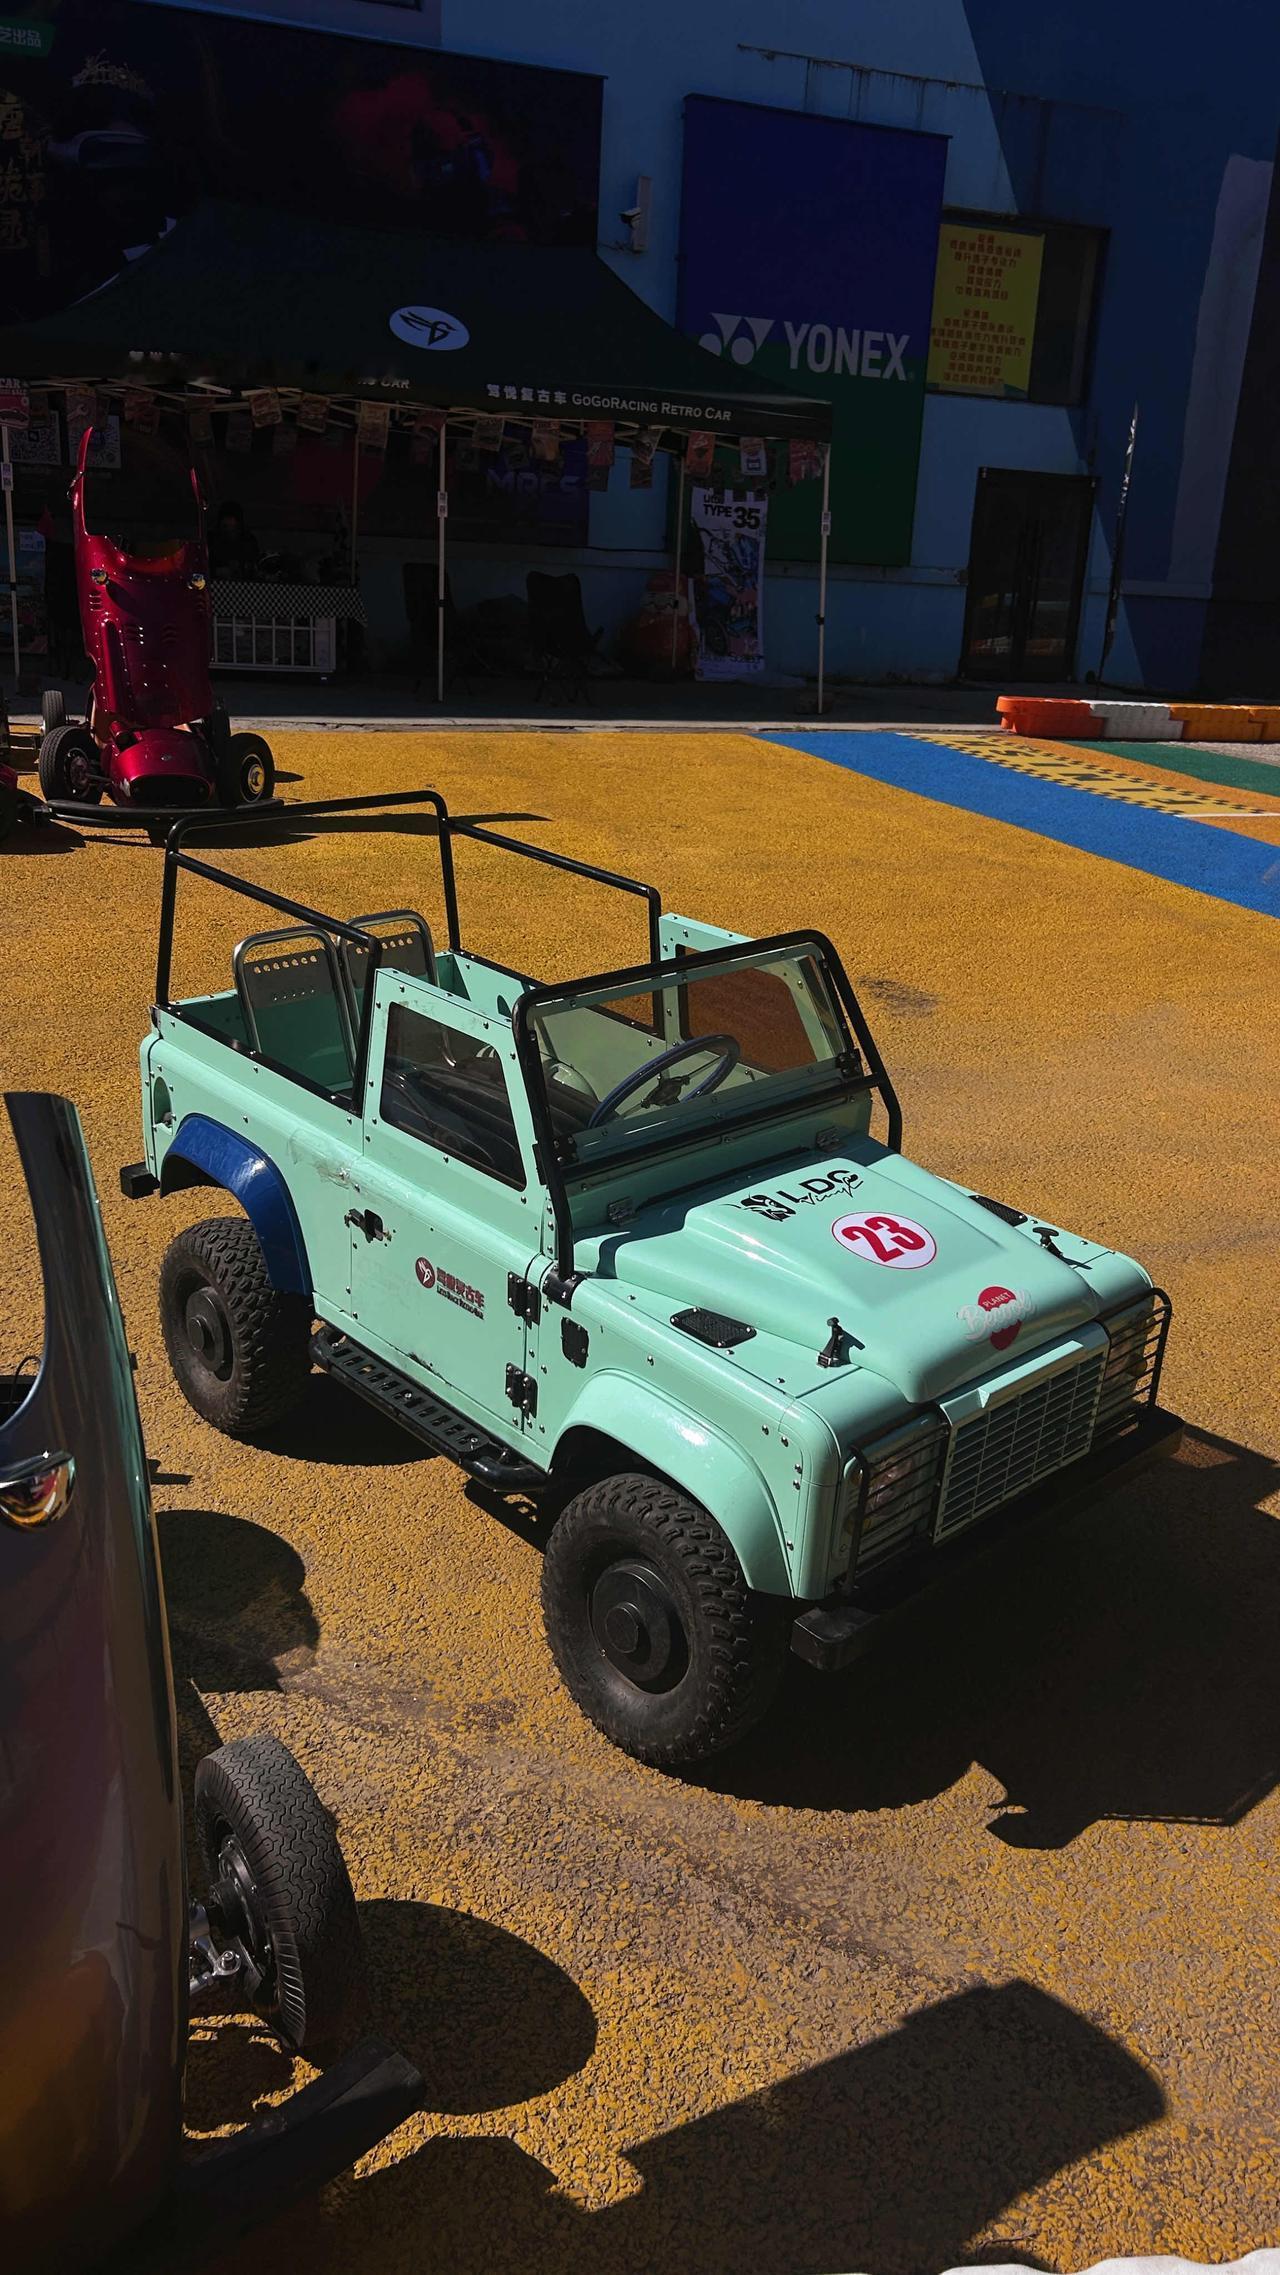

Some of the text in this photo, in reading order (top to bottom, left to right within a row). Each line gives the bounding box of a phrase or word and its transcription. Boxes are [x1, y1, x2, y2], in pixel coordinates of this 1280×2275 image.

[783, 320, 910, 382] YONEX
[661, 401, 702, 418] RETRO
[704, 407, 733, 421] CAR
[703, 504, 760, 530] TYPE 35
[841, 1216, 926, 1263] 23
[982, 1291, 1012, 1308] PLANET
